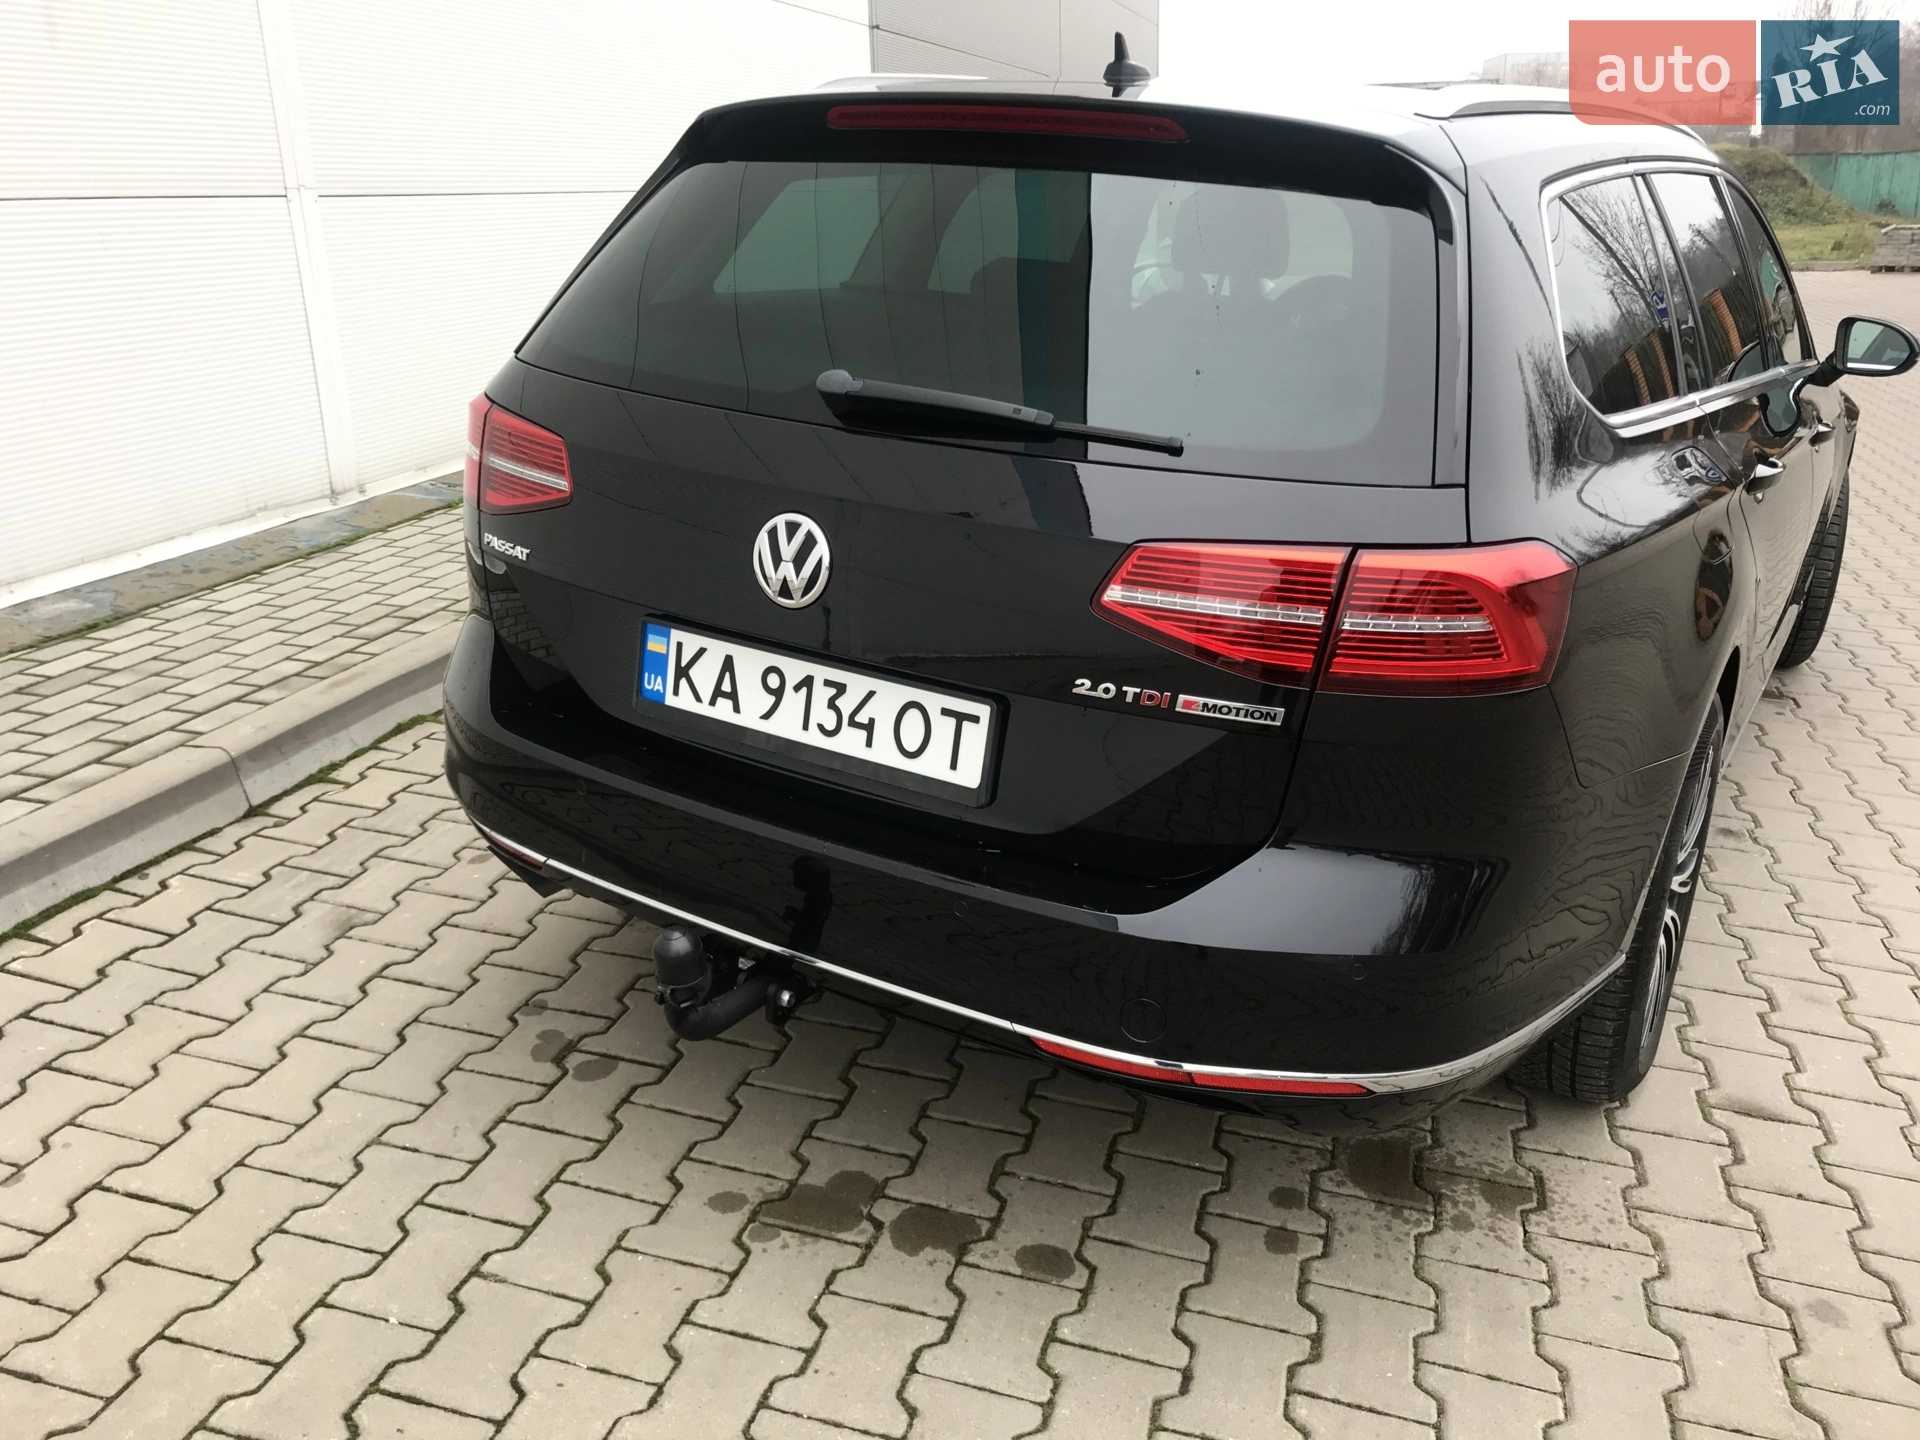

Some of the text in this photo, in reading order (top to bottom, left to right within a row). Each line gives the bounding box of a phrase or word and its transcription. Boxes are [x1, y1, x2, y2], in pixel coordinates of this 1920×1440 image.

[484, 532, 531, 562] PASSAT
[644, 672, 664, 694] UA
[672, 641, 981, 771] KA 9134 OT
[1121, 685, 1172, 708] TDI
